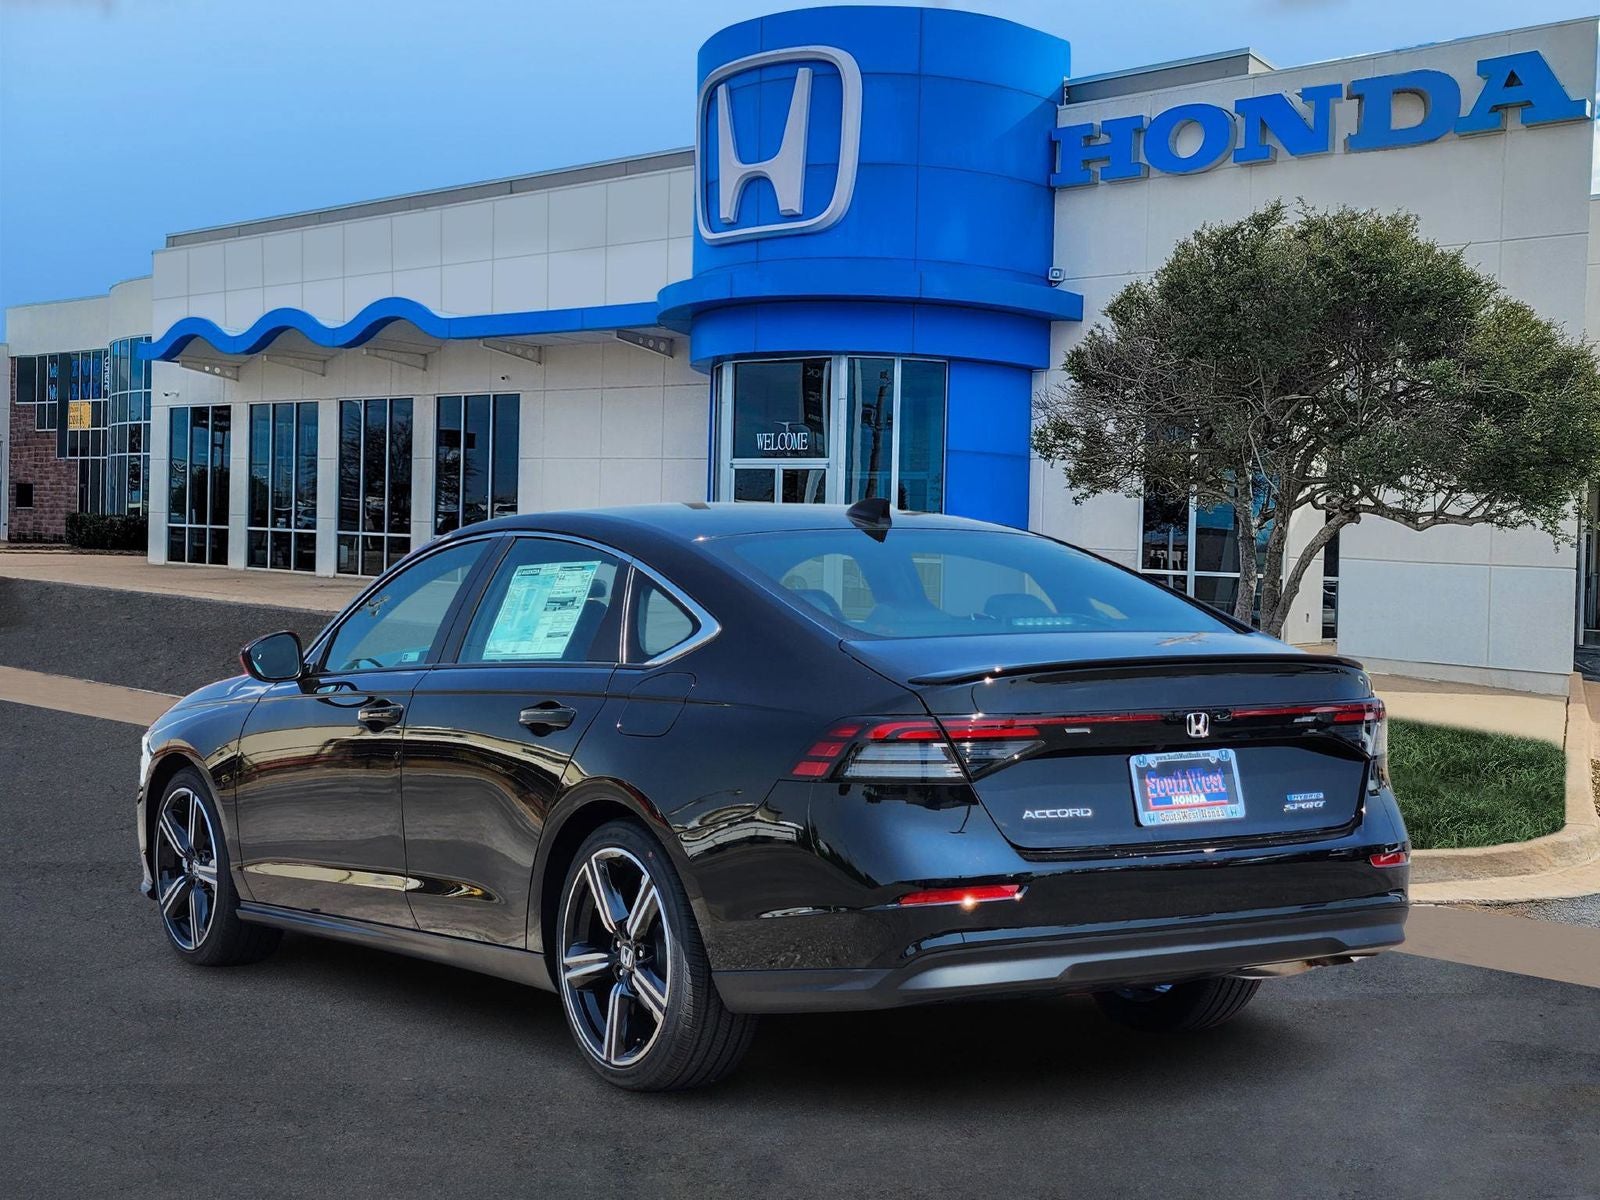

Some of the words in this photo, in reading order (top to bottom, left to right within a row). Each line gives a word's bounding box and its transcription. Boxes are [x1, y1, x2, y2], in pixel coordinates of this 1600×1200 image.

[1050, 50, 1592, 188] HONDA
[756, 432, 808, 451] WELCOME
[1172, 794, 1207, 805] HONDA
[1022, 808, 1092, 819] ACCORD
